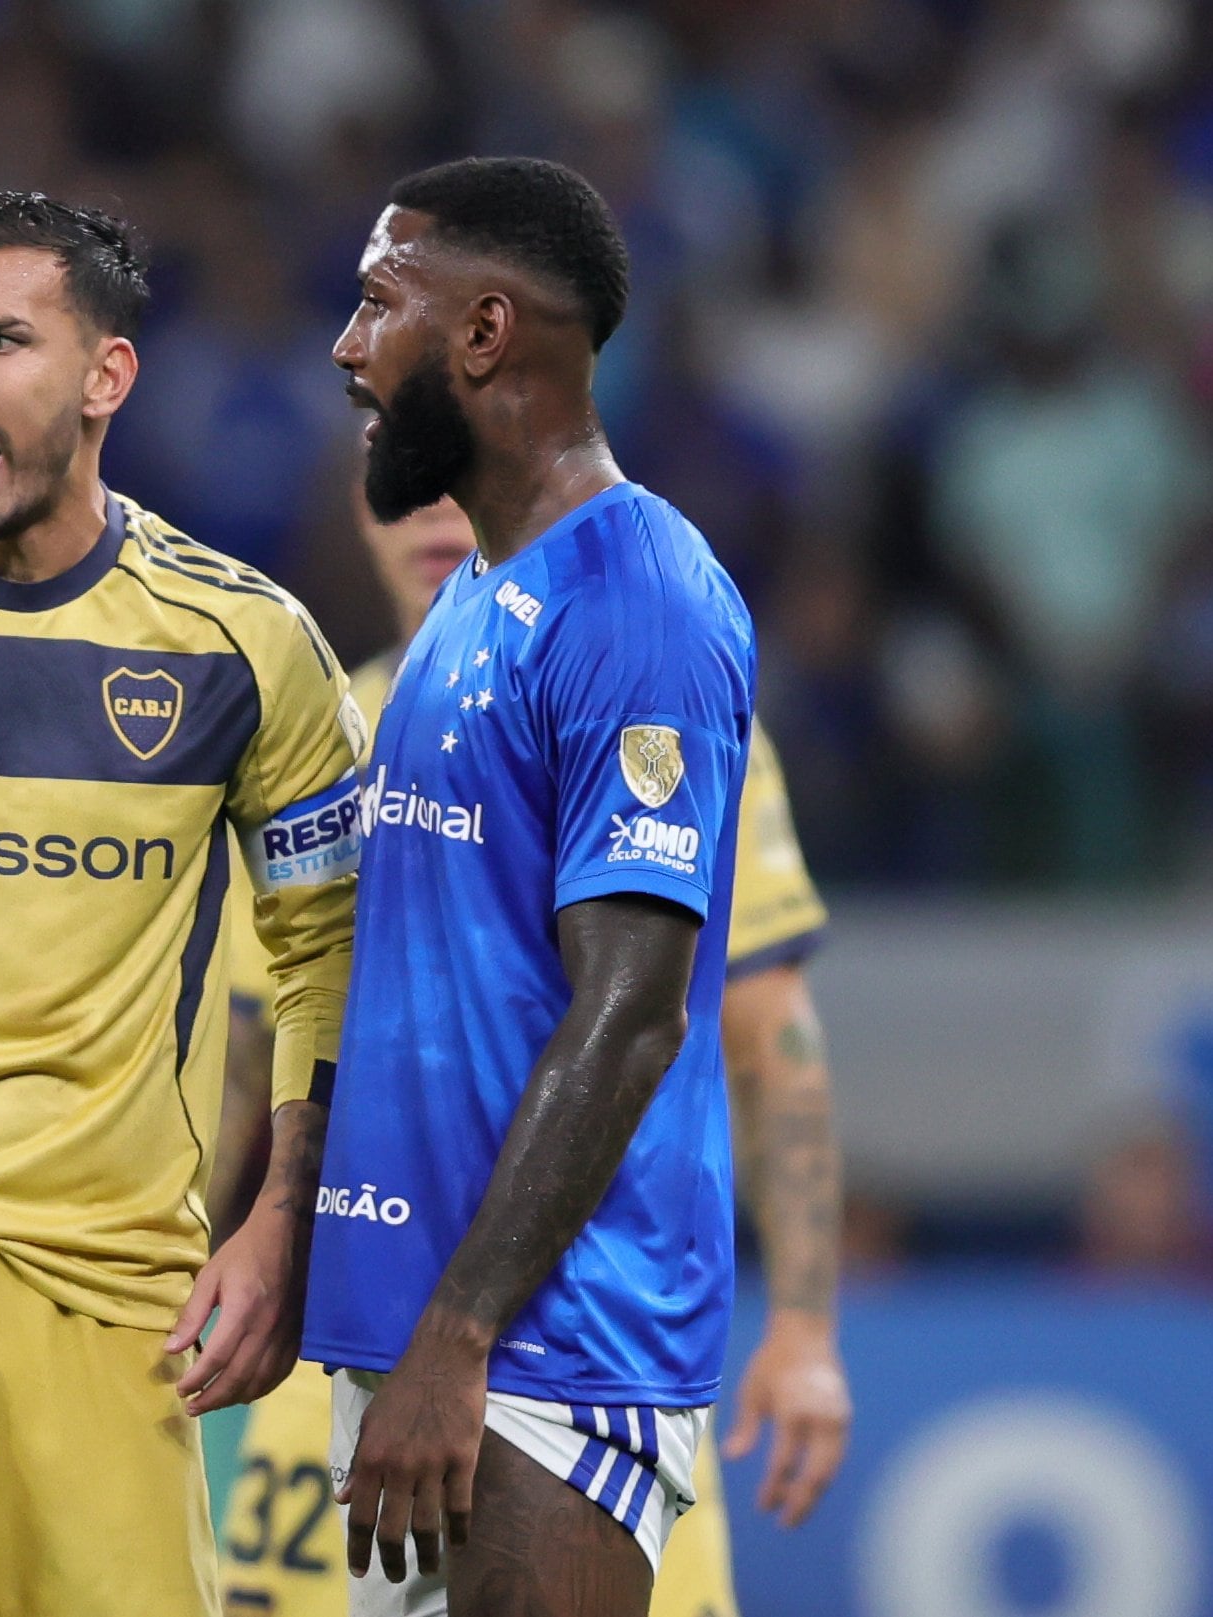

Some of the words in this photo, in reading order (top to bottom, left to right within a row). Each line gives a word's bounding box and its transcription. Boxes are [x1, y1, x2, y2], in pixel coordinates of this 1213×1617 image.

[114, 698, 172, 719] CABJ
[633, 816, 699, 861] OMO
[607, 848, 641, 863] CICLO
[645, 849, 695, 875] RÁPIDO
[316, 1183, 411, 1226] DIGÃO
[228, 1456, 327, 1571] 32
